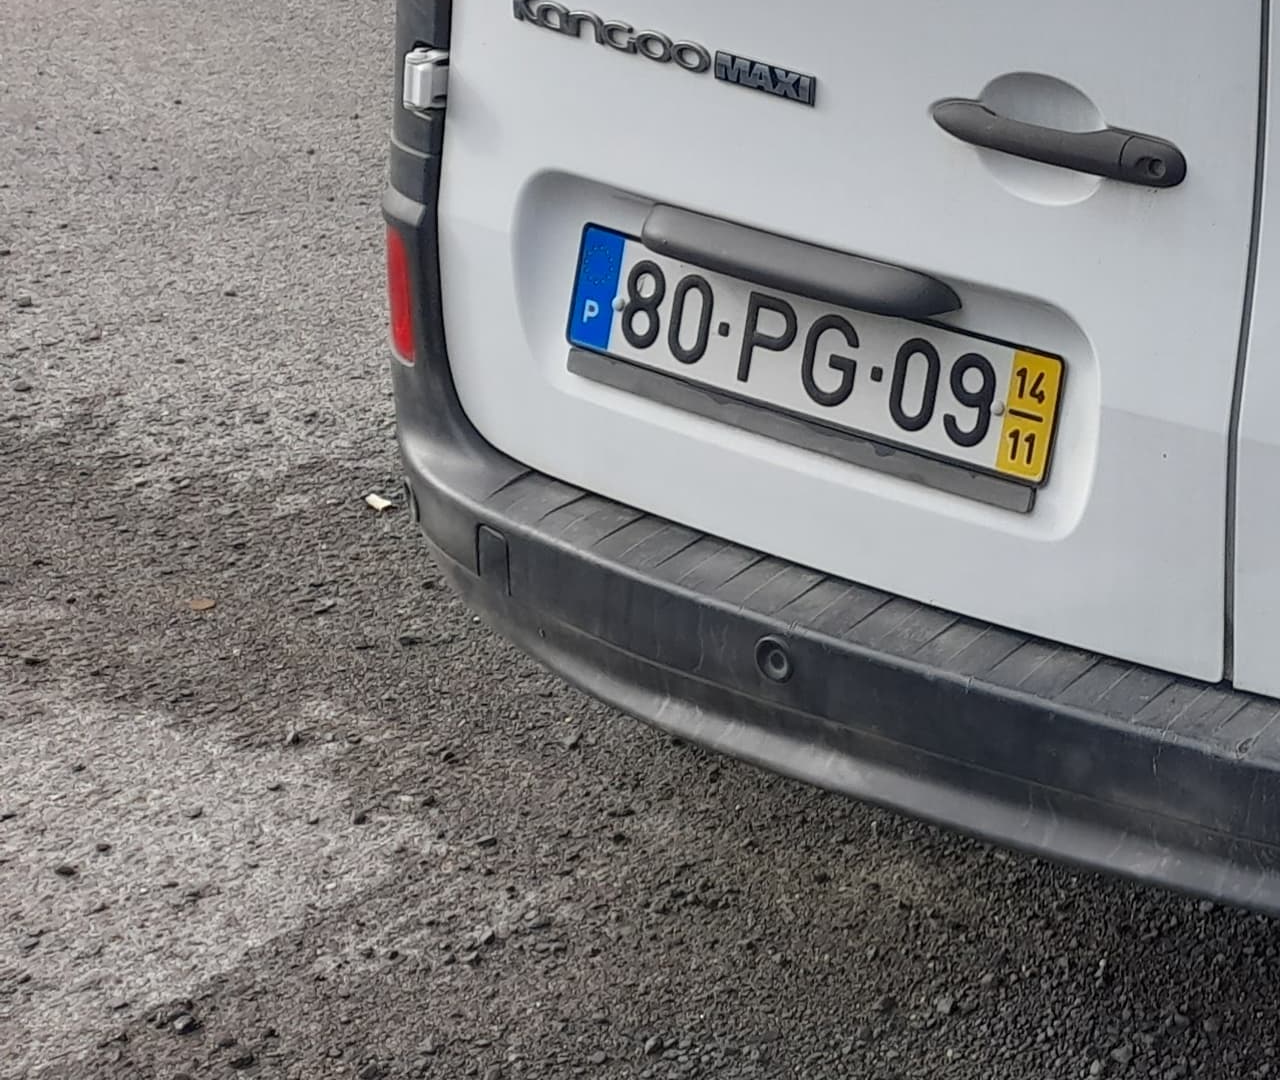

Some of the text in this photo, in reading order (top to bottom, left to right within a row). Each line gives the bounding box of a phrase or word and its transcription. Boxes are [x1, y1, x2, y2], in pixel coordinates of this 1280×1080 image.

[715, 51, 813, 104] MAXI
[582, 300, 599, 324] P
[1014, 366, 1046, 405] 14
[1007, 429, 1037, 465] 11
